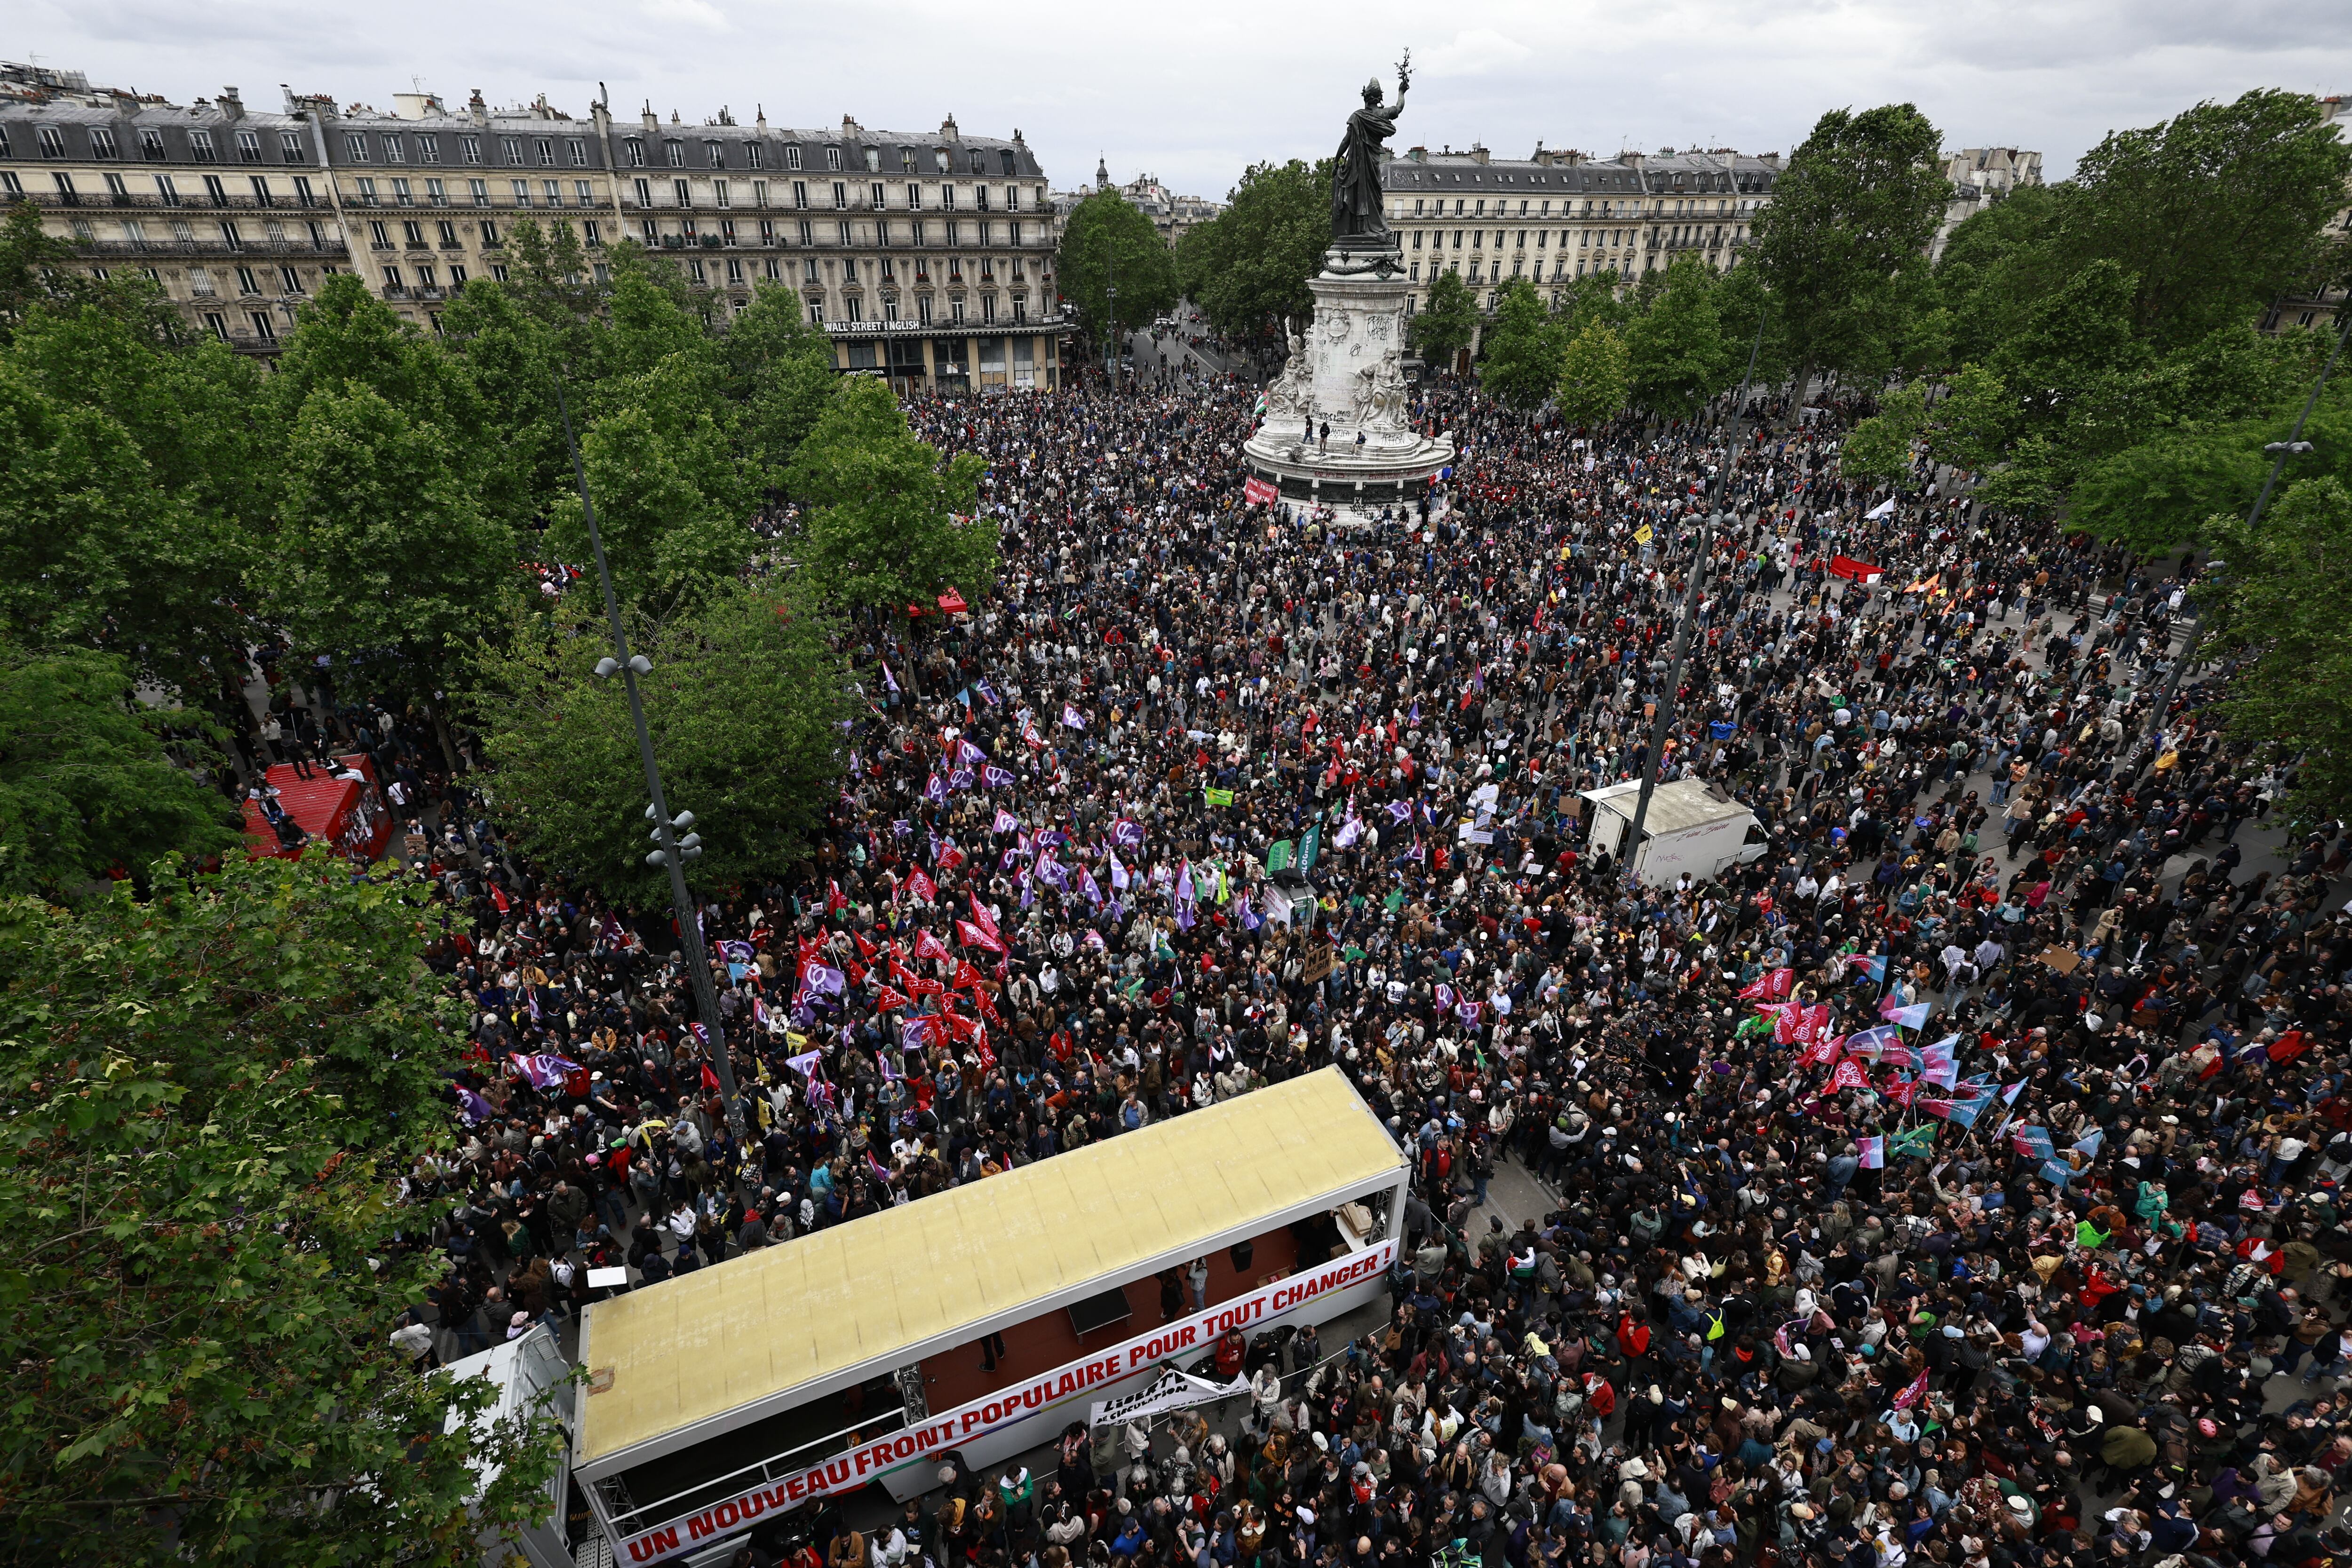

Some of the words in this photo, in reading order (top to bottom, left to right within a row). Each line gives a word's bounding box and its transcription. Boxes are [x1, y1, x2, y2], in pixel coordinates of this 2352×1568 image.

[824, 323, 848, 332] WALL
[851, 321, 881, 332] STREET
[884, 320, 919, 331] ENGLISH
[1331, 428, 1351, 437] ANTIFA
[1248, 477, 1258, 487] FAIRE
[1260, 484, 1276, 493] FRONT
[1308, 947, 1327, 967] NO
[1306, 958, 1329, 979] PASARAN
[628, 1526, 679, 1562] UN
[686, 1460, 850, 1540] NOUVEAU
[855, 1419, 955, 1476] FRONT
[961, 1354, 1122, 1436] POPULAIRE
[1129, 1325, 1197, 1369] POUR
[1202, 1297, 1266, 1337] TOUT
[1272, 1259, 1377, 1311] CHANGER
[1383, 1247, 1392, 1265] !
[1110, 1385, 1188, 1420] CIRCULATION
